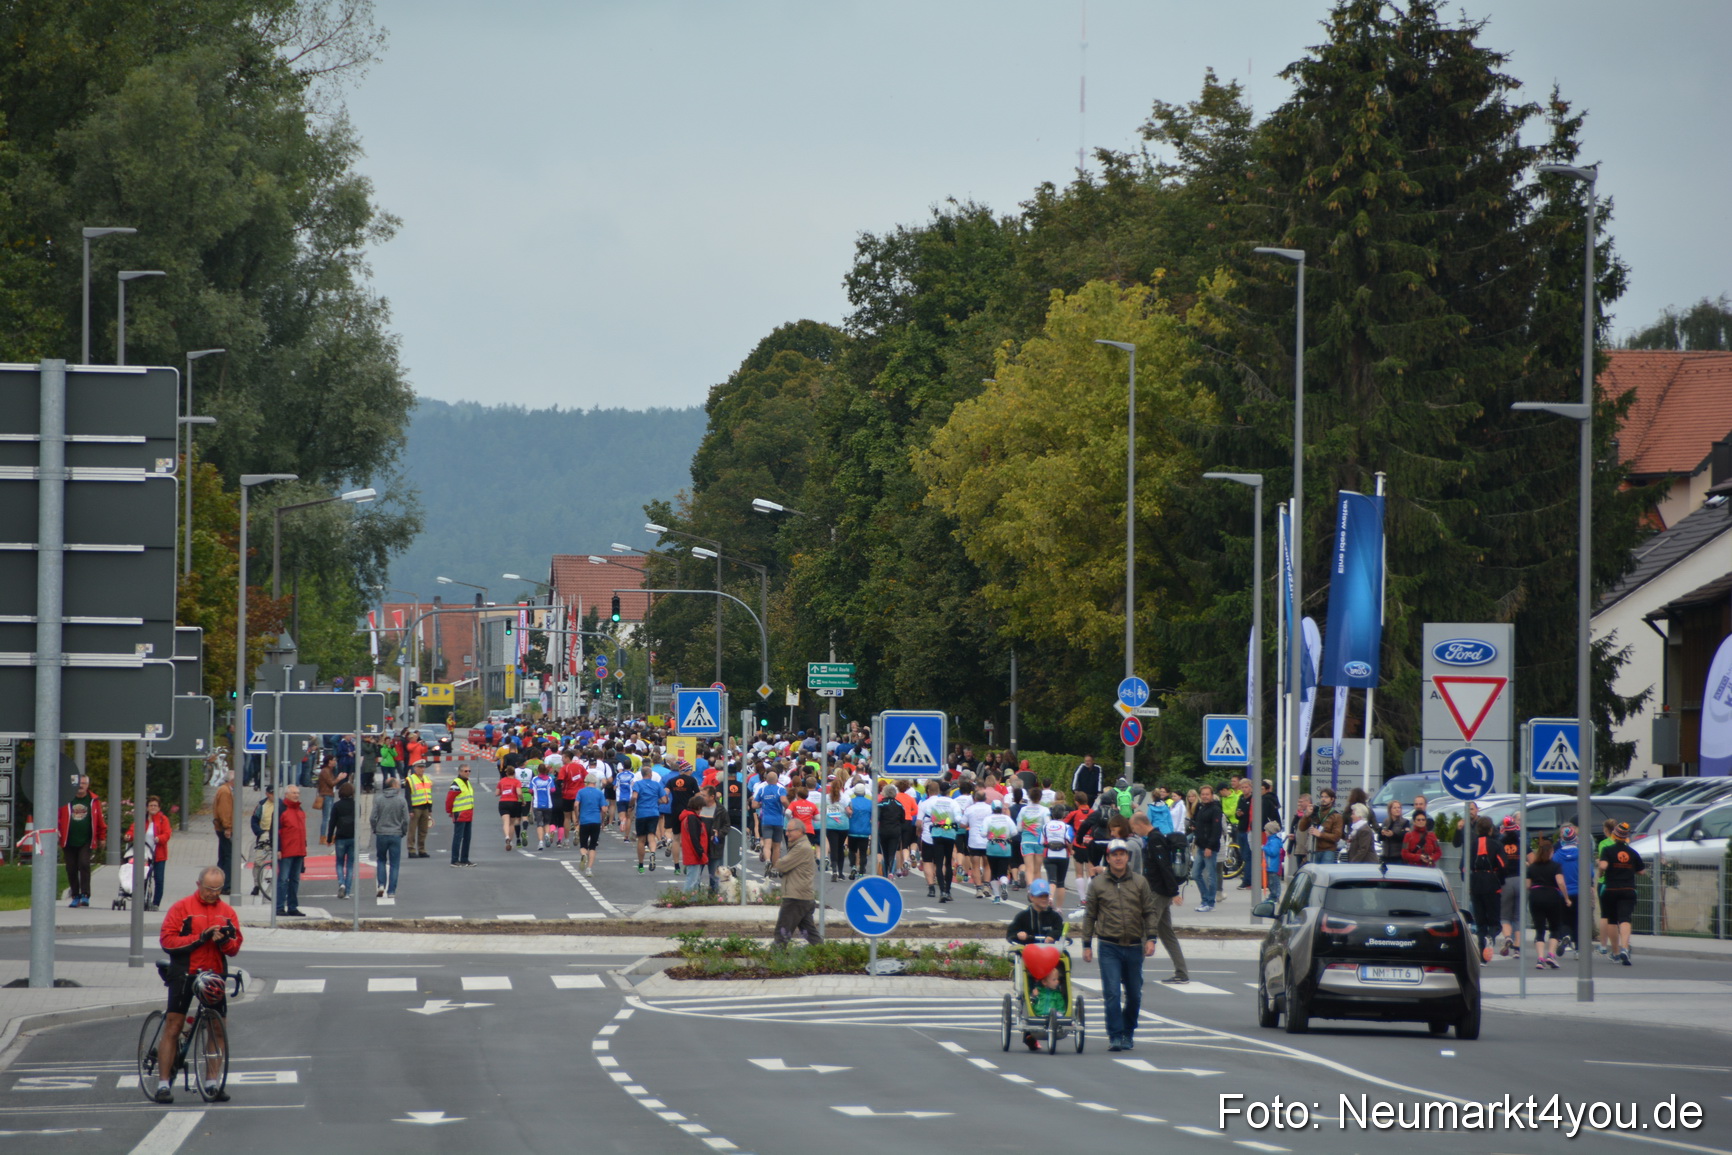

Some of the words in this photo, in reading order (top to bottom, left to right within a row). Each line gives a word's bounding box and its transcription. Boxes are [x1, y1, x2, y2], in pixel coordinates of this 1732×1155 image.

[1445, 642, 1483, 661] Ford
[1372, 967, 1386, 978] NM
[1391, 968, 1403, 978] TT
[1405, 969, 1412, 978] 6
